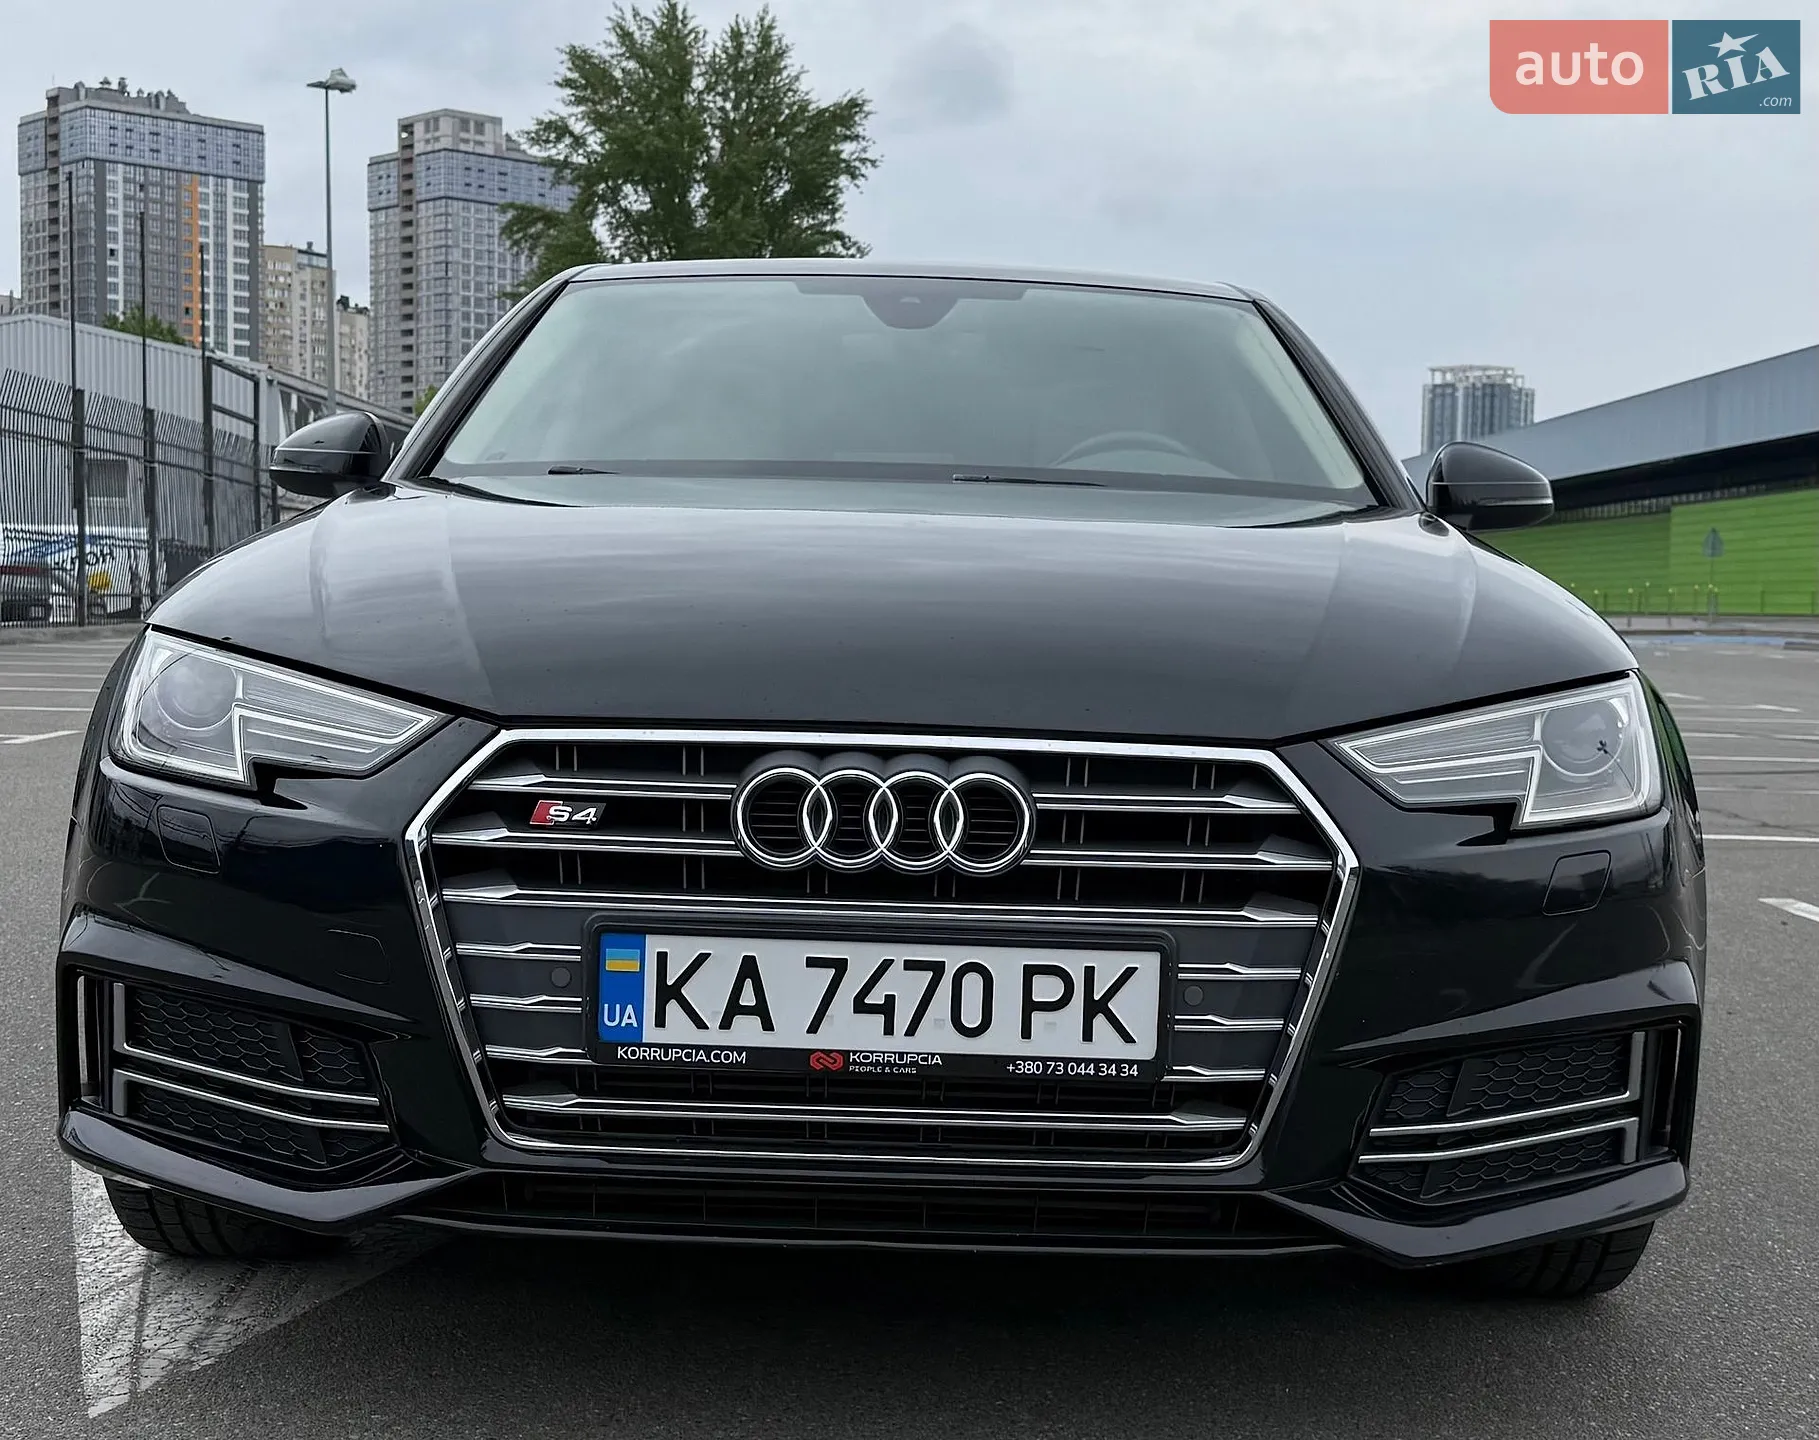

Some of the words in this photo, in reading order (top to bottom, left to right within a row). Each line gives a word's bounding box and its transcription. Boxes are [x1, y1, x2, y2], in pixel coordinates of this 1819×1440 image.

[546, 805, 597, 825] S4
[653, 950, 776, 1032] KA
[805, 957, 994, 1038] 7470
[1020, 963, 1138, 1044] PK
[604, 1003, 638, 1028] UA
[617, 1046, 746, 1064] KORRUPCIA.COM
[849, 1052, 943, 1066] KORRUPCIA
[1006, 1060, 1043, 1075] +380
[1046, 1061, 1064, 1075] 73
[1067, 1062, 1095, 1076] 044
[1098, 1063, 1117, 1076] 34
[1119, 1063, 1139, 1077] 34
